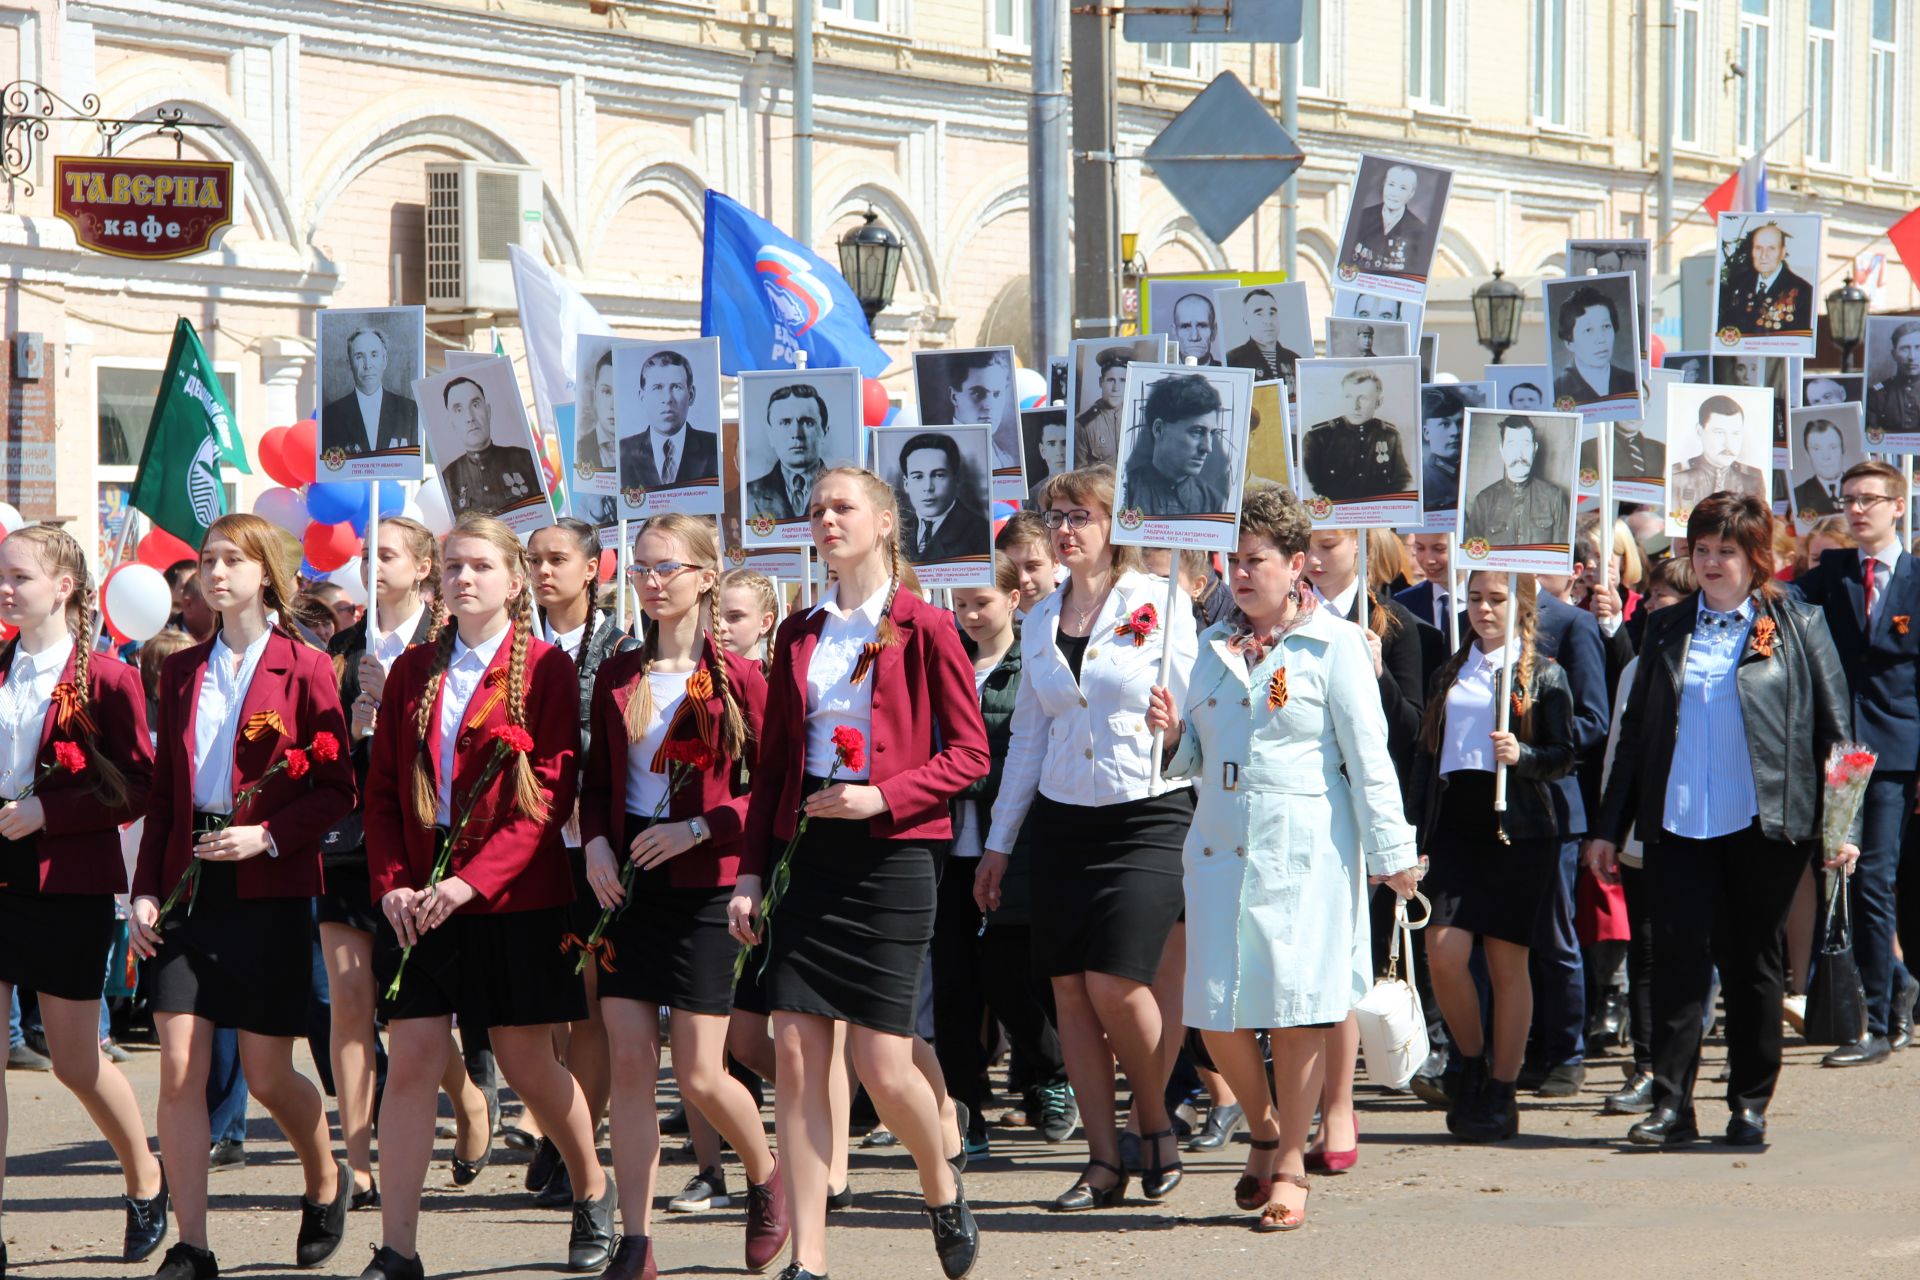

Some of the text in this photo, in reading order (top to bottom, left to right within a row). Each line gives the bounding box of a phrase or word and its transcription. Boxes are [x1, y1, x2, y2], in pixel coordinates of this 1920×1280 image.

[65, 171, 222, 208] ТАВЕРНА
[103, 215, 181, 243] кафе
[6, 447, 48, 460] ВОЕННЫЙ
[1, 463, 52, 476] ГОСПИТАЛЬ
